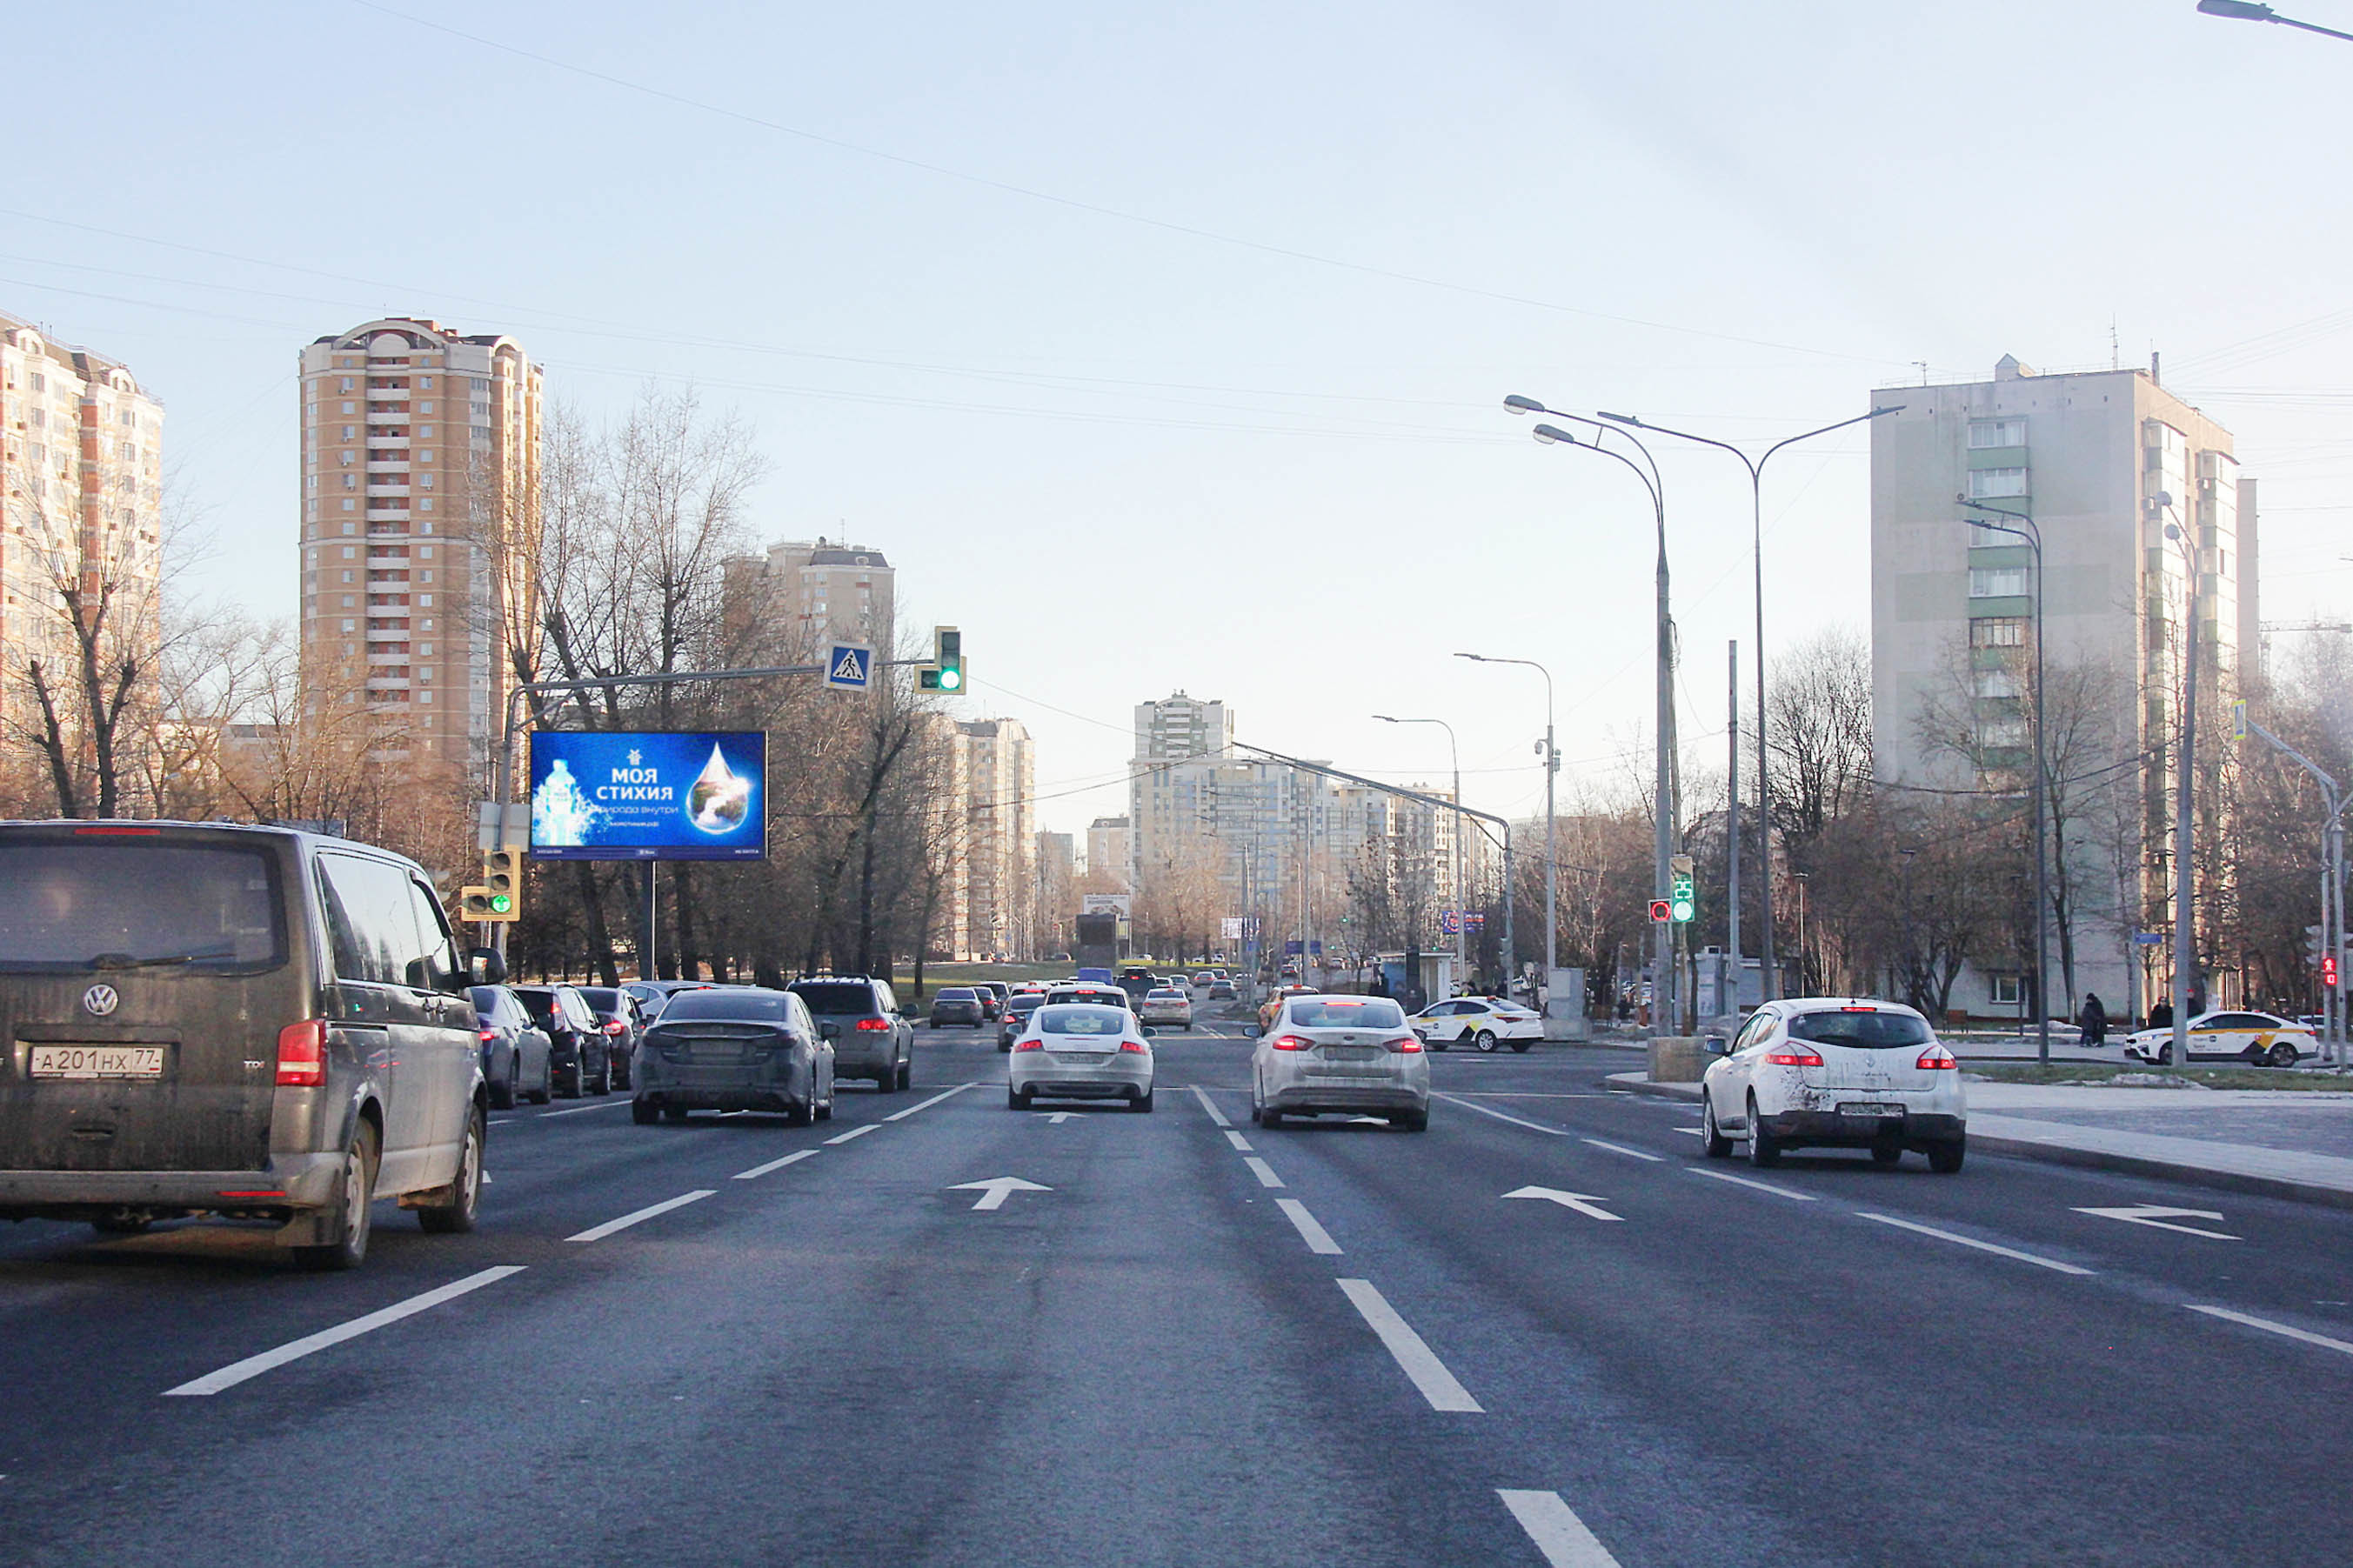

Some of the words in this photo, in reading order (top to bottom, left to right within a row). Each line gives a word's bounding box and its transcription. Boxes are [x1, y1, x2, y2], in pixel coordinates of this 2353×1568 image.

[612, 768, 658, 784] МОЯ
[597, 786, 673, 800] СТИХИЯ
[641, 806, 678, 816] внутри
